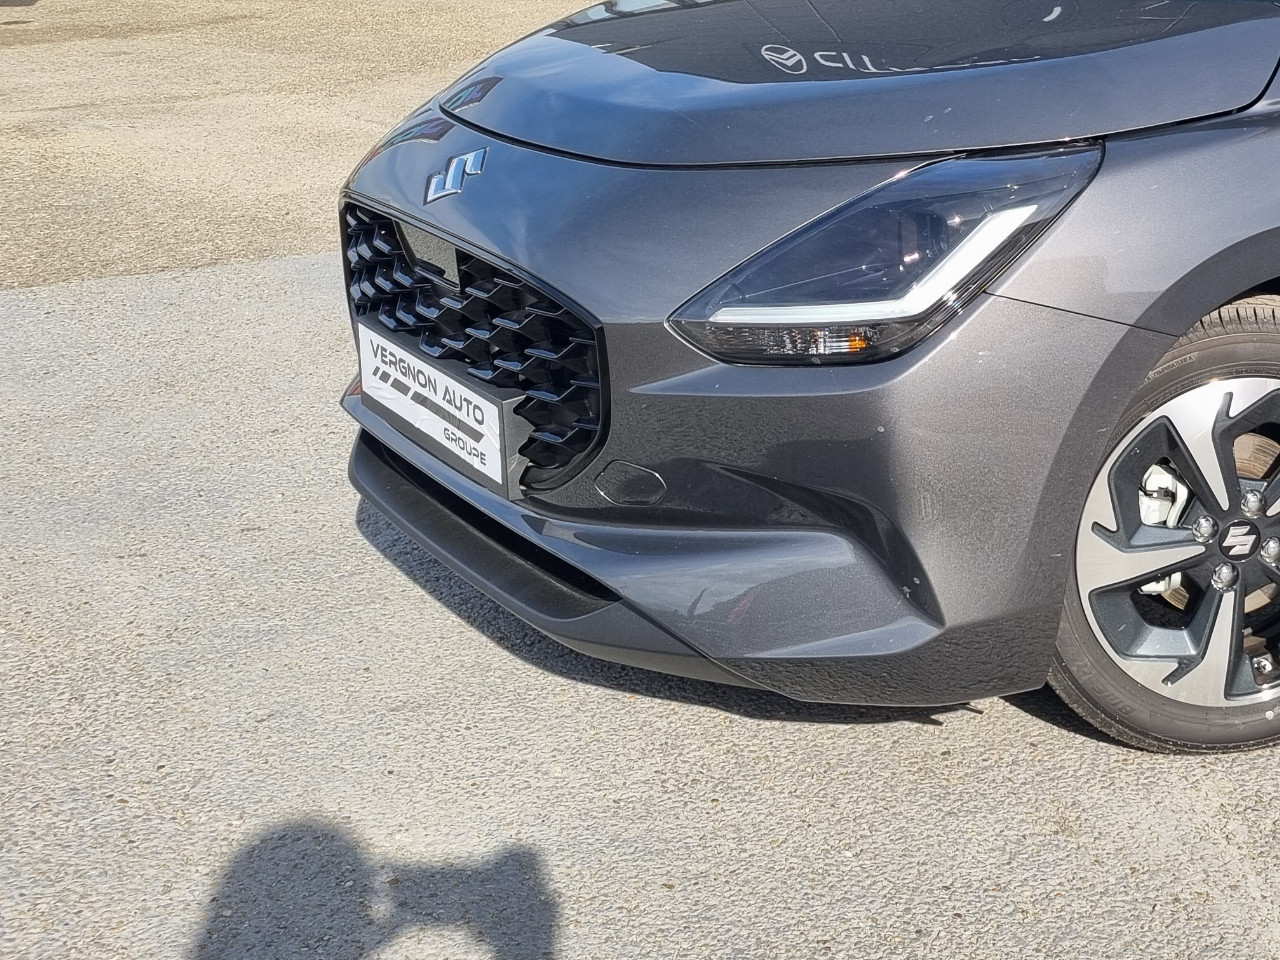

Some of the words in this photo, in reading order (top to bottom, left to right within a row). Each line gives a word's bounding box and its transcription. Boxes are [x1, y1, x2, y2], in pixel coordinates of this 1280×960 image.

[370, 339, 437, 396] VERGNON
[442, 385, 485, 426] AUTO
[443, 427, 487, 466] GROUPE
